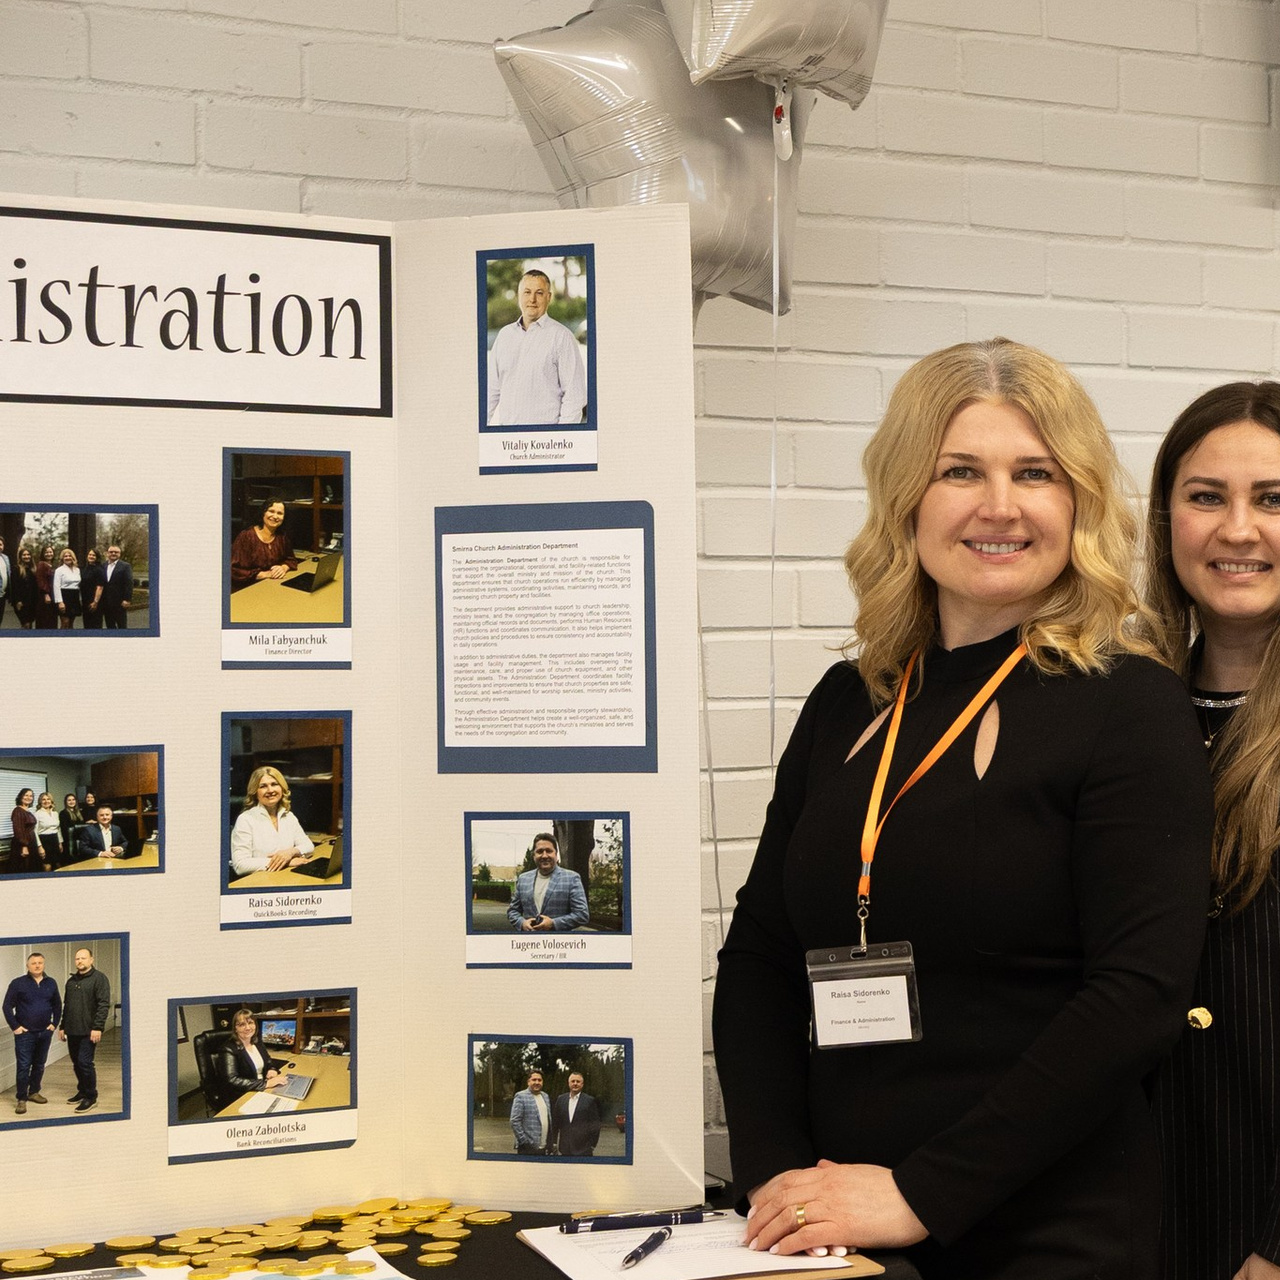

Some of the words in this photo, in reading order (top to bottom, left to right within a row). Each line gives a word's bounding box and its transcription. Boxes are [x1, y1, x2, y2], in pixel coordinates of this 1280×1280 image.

[0, 257, 367, 360] istration
[502, 440, 528, 452] Vitaliy
[530, 439, 574, 450] Kovalenko
[248, 634, 269, 645] Mila
[272, 634, 328, 647] Fabyanchuk
[248, 898, 273, 908] Raisa
[275, 894, 322, 907] Sidorenko
[511, 940, 540, 951] Eugene
[542, 939, 586, 949] Volosevich
[853, 989, 890, 997] Sidorenko
[226, 1127, 253, 1138] Olena
[255, 1122, 306, 1136] Zabolotska
[253, 1136, 297, 1146] Reconciliations
